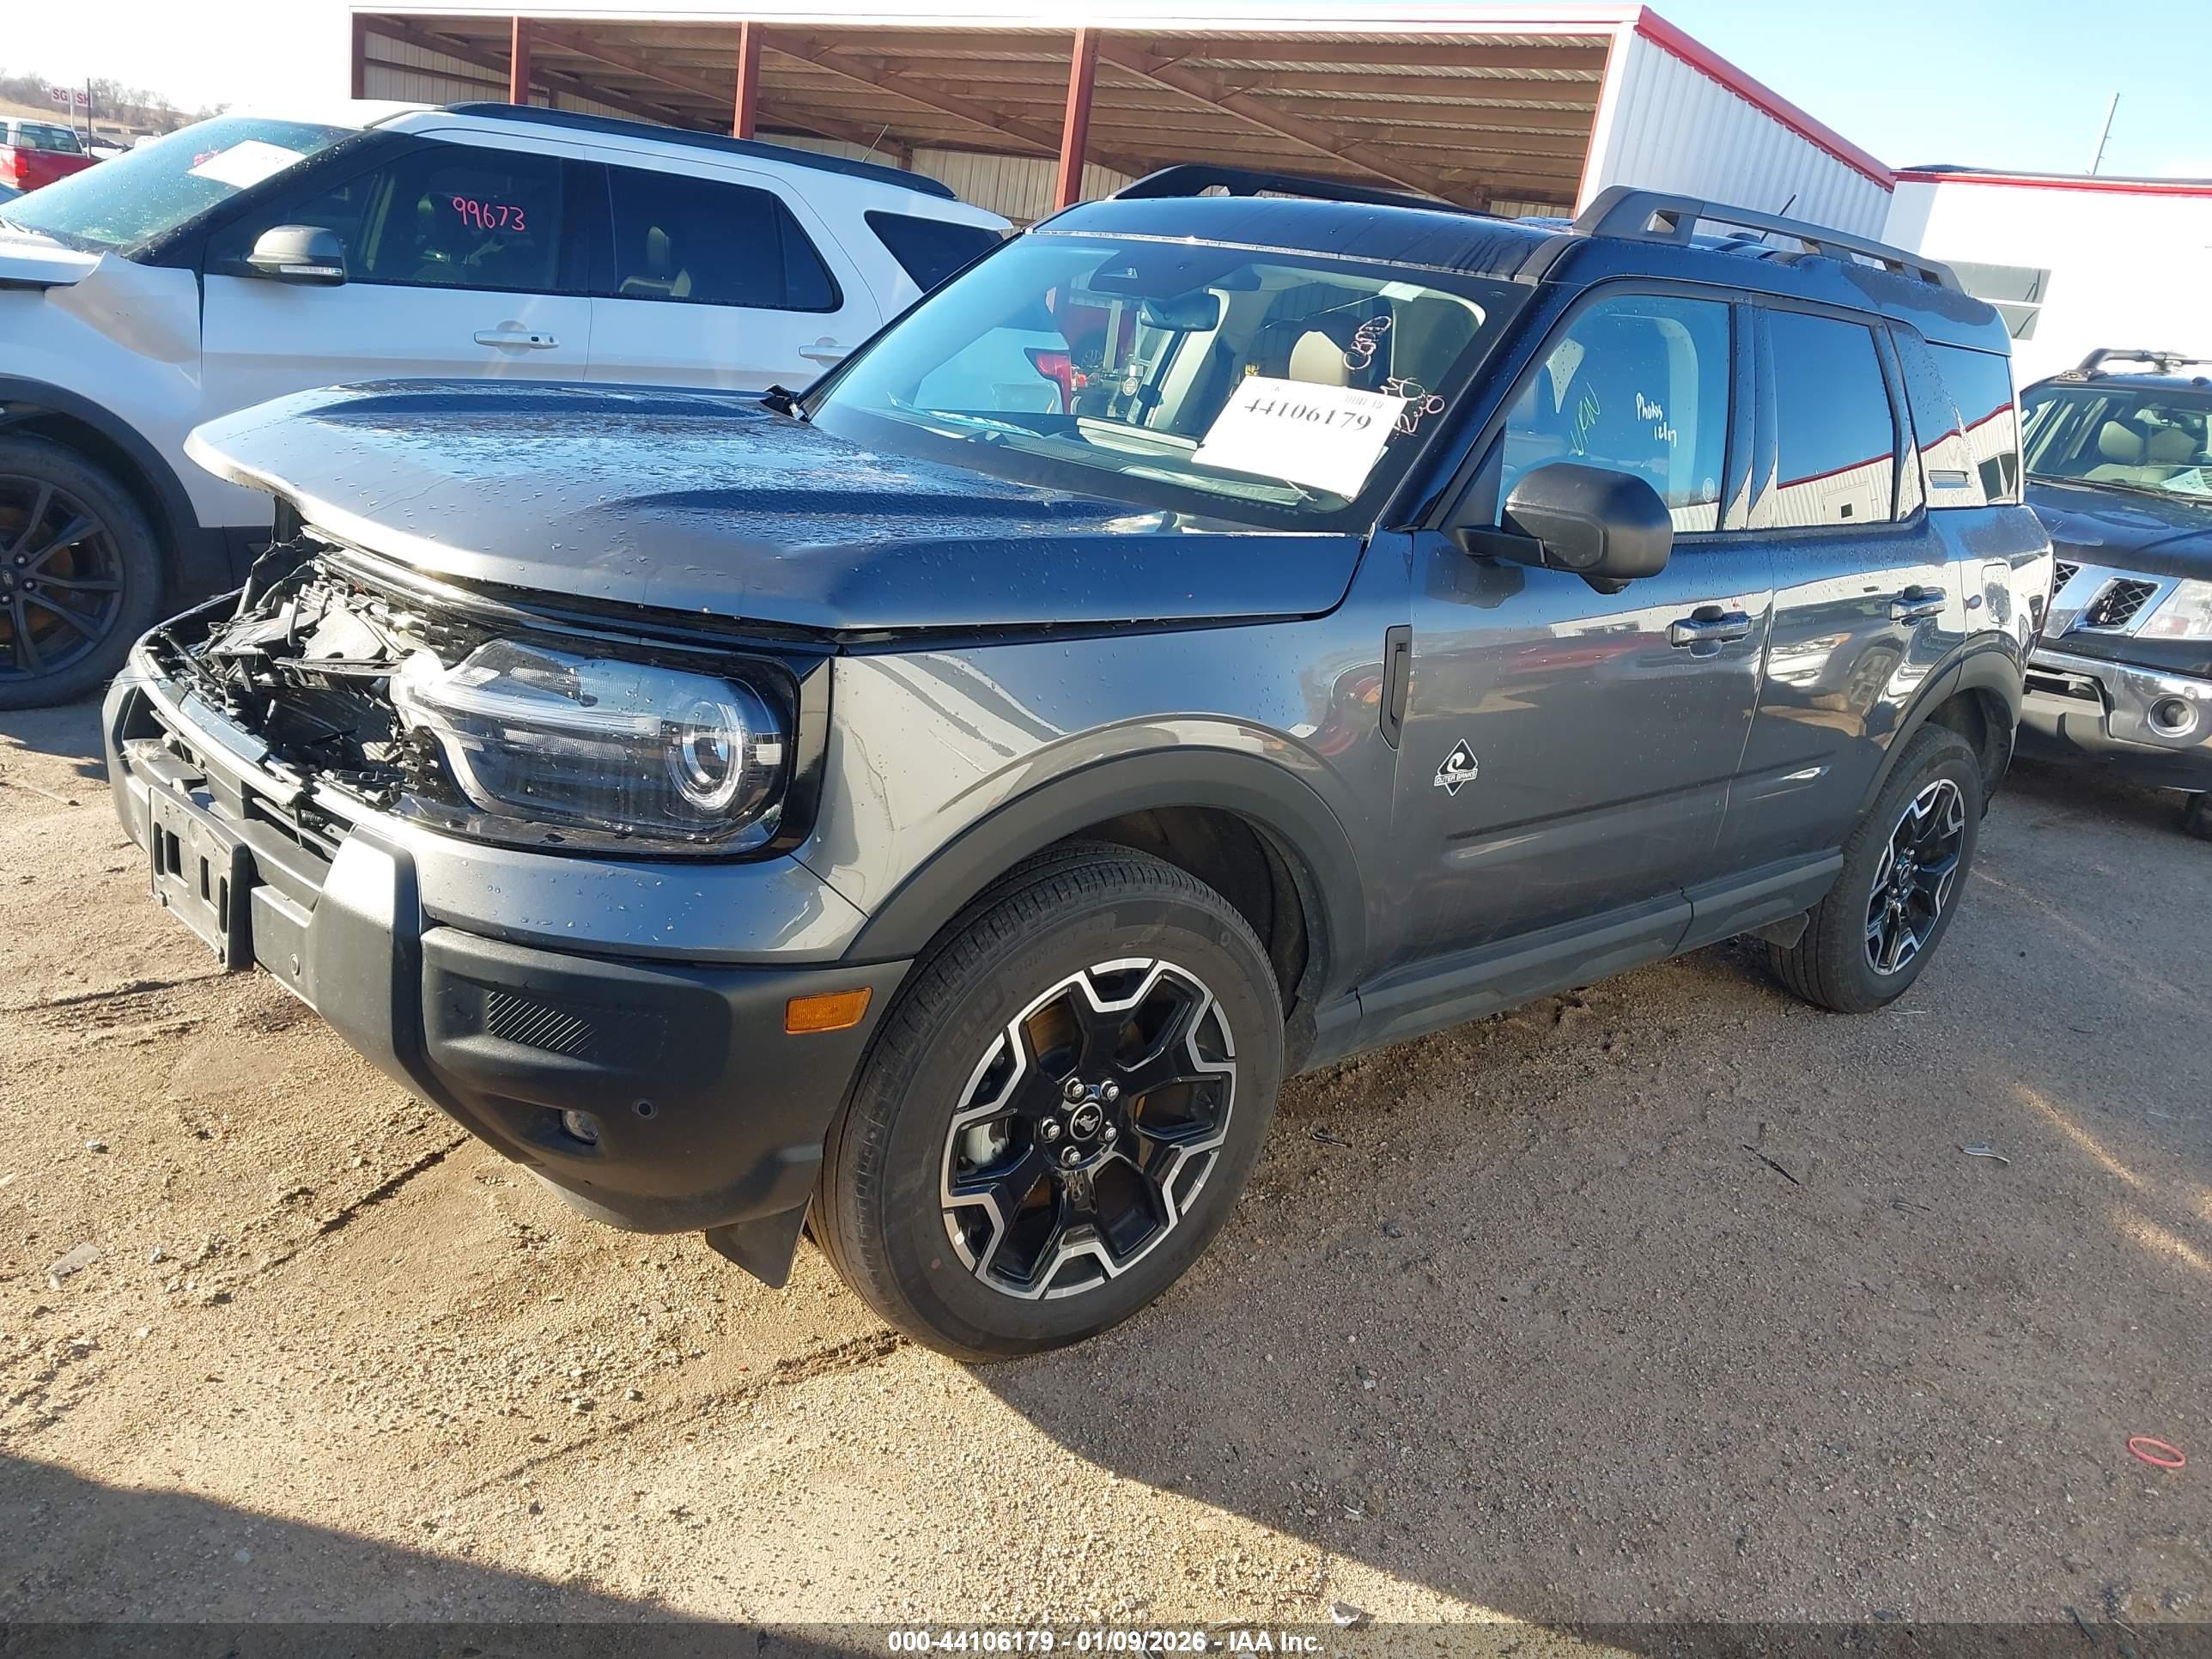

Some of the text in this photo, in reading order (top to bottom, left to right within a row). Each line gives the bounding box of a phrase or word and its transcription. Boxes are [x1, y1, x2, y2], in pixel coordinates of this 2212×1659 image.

[53, 88, 68, 101] SG
[452, 196, 526, 232] 99673
[1243, 397, 1373, 431] 44106179
[1635, 392, 1663, 422] Photos
[1436, 770, 1476, 784] OUTER BANKS
